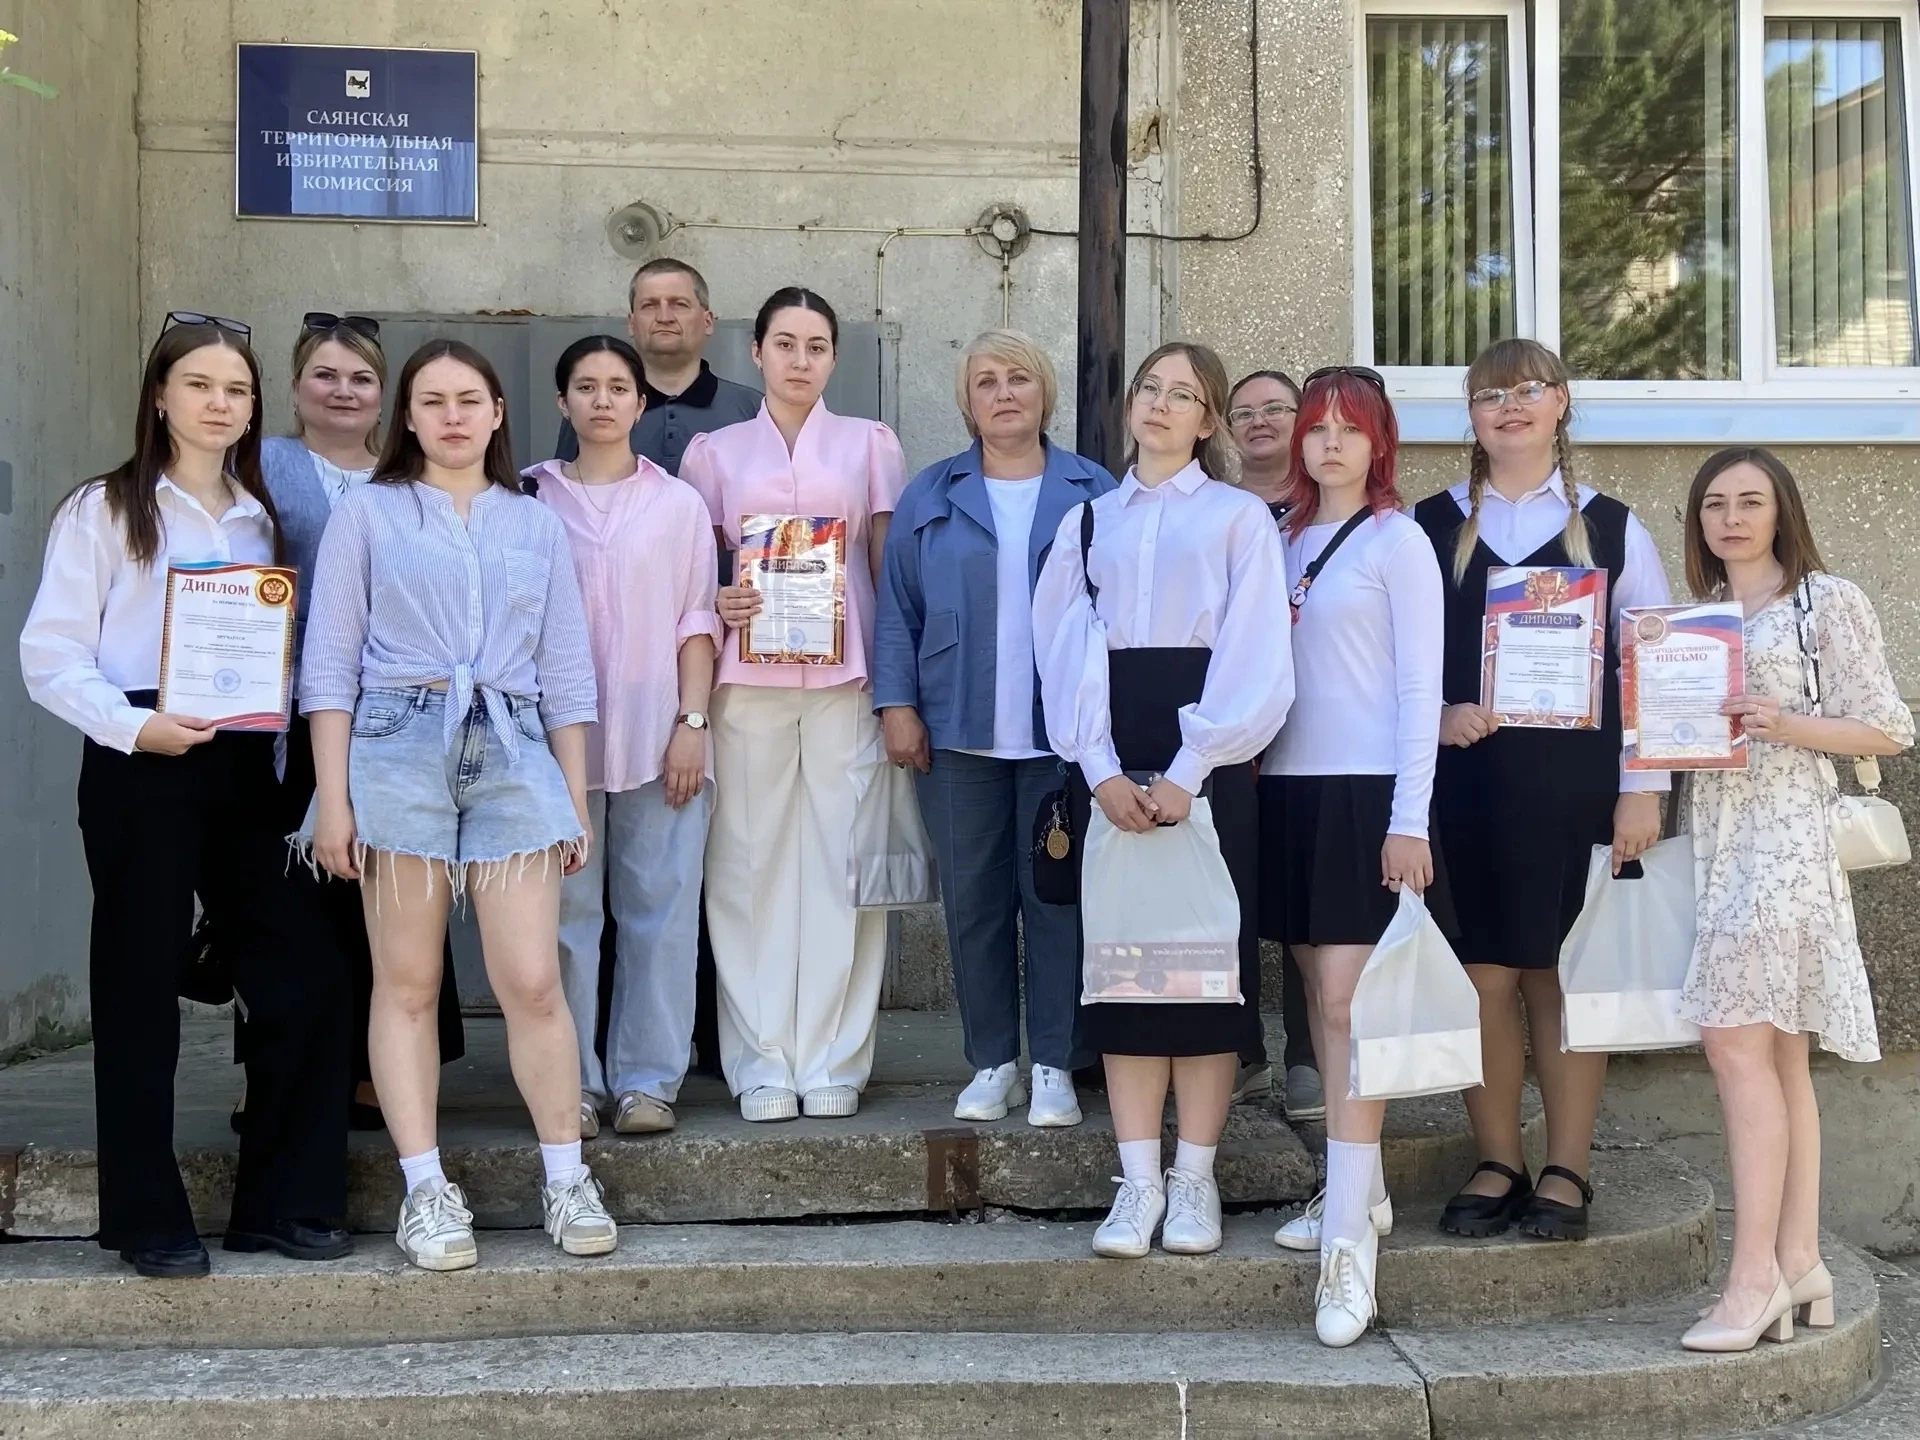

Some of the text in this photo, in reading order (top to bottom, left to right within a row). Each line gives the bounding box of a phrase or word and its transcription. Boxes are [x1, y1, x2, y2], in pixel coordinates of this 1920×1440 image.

[306, 110, 410, 128] САЯНСКАЯ
[260, 130, 453, 151] ТЕРРИТОРИАЛЬНАЯ
[276, 152, 440, 173] ИЗБИРАТЕЛЬНАЯ
[302, 175, 414, 193] КОМИССИЯ
[1519, 614, 1572, 626] ДИПЛОМ
[1656, 652, 1708, 663] ПИСЬМО
